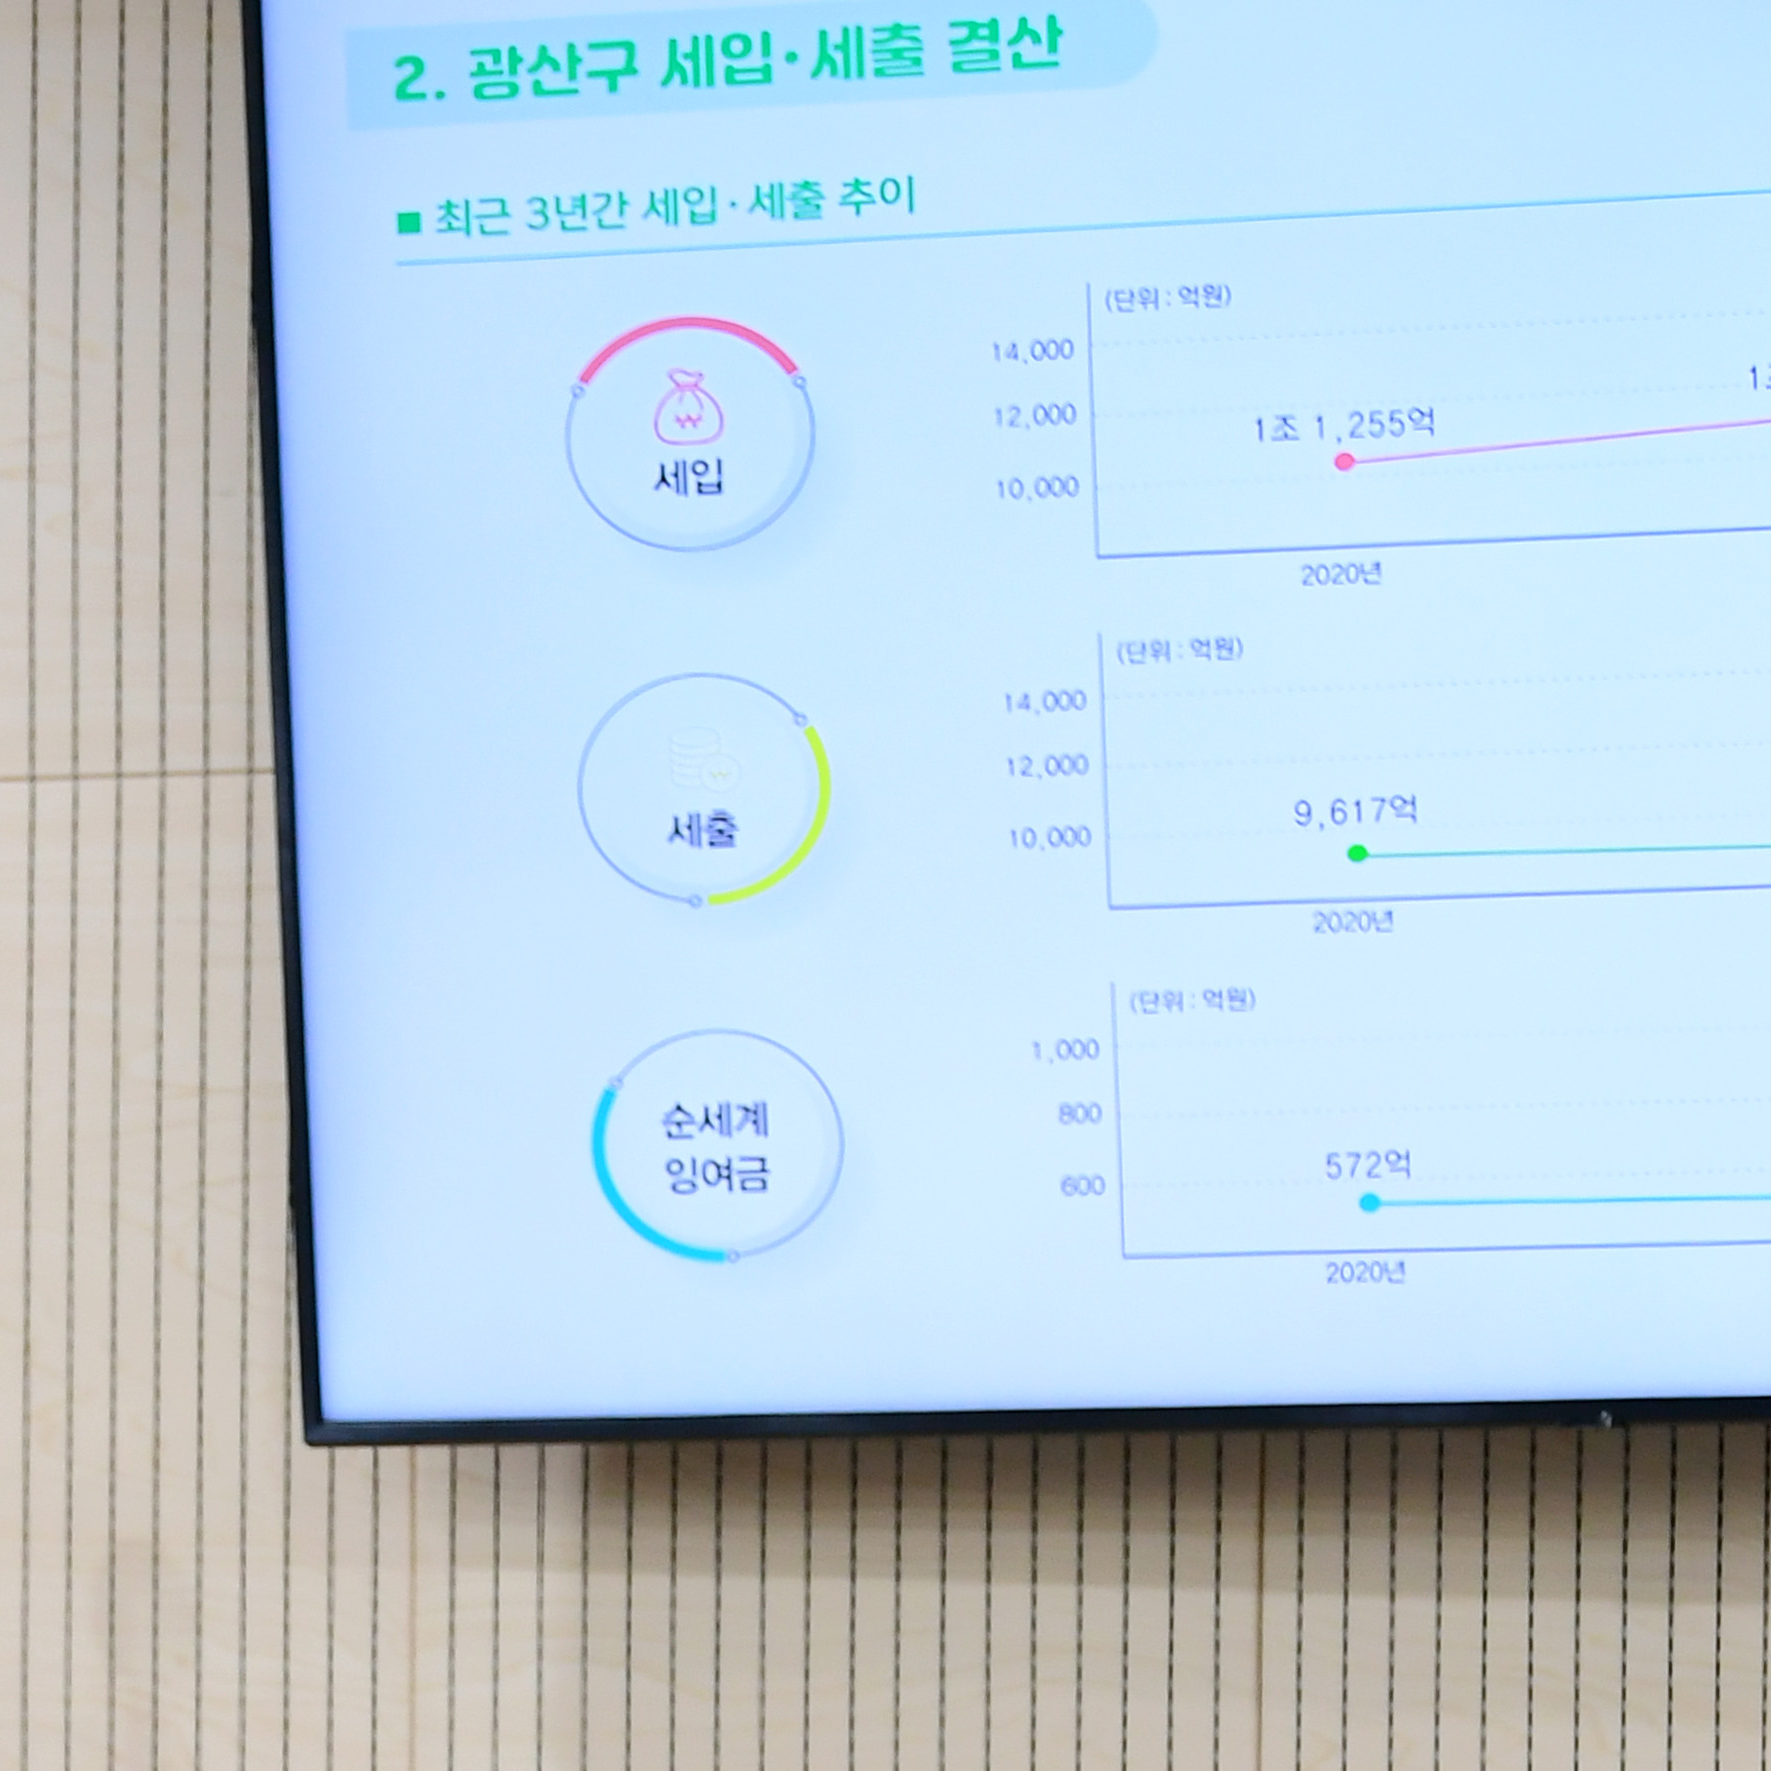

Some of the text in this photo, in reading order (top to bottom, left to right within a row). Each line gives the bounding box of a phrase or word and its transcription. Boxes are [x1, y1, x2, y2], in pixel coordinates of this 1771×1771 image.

[393, 54, 446, 101] 2.
[469, 40, 639, 101] 광산구
[947, 14, 1064, 74] 결산
[436, 197, 511, 237] 최근
[526, 191, 629, 232] 3년간
[838, 174, 915, 217] 추이
[992, 338, 1075, 365] 14,000
[1749, 364, 1771, 391] 1
[994, 402, 1077, 431] 12,000
[1255, 406, 1435, 445] 1조 1,255억
[653, 458, 724, 497] 세입
[996, 475, 1080, 503] 10,000
[1301, 561, 1382, 587] 2020년
[1004, 689, 1087, 717] 14,000
[1007, 753, 1090, 781] 12,000
[1293, 793, 1418, 832] 9,617억
[666, 808, 739, 850] 세출
[1010, 825, 1092, 852] 10,000
[1313, 910, 1394, 935] 2020년
[1032, 1037, 1101, 1065] 1,000
[661, 1100, 770, 1142] 순세계
[1058, 1101, 1103, 1126] 800
[666, 1156, 771, 1196] 잉여금
[1325, 1148, 1412, 1181] 572억
[1060, 1174, 1106, 1198] 600
[1325, 1259, 1407, 1286] 2020년
